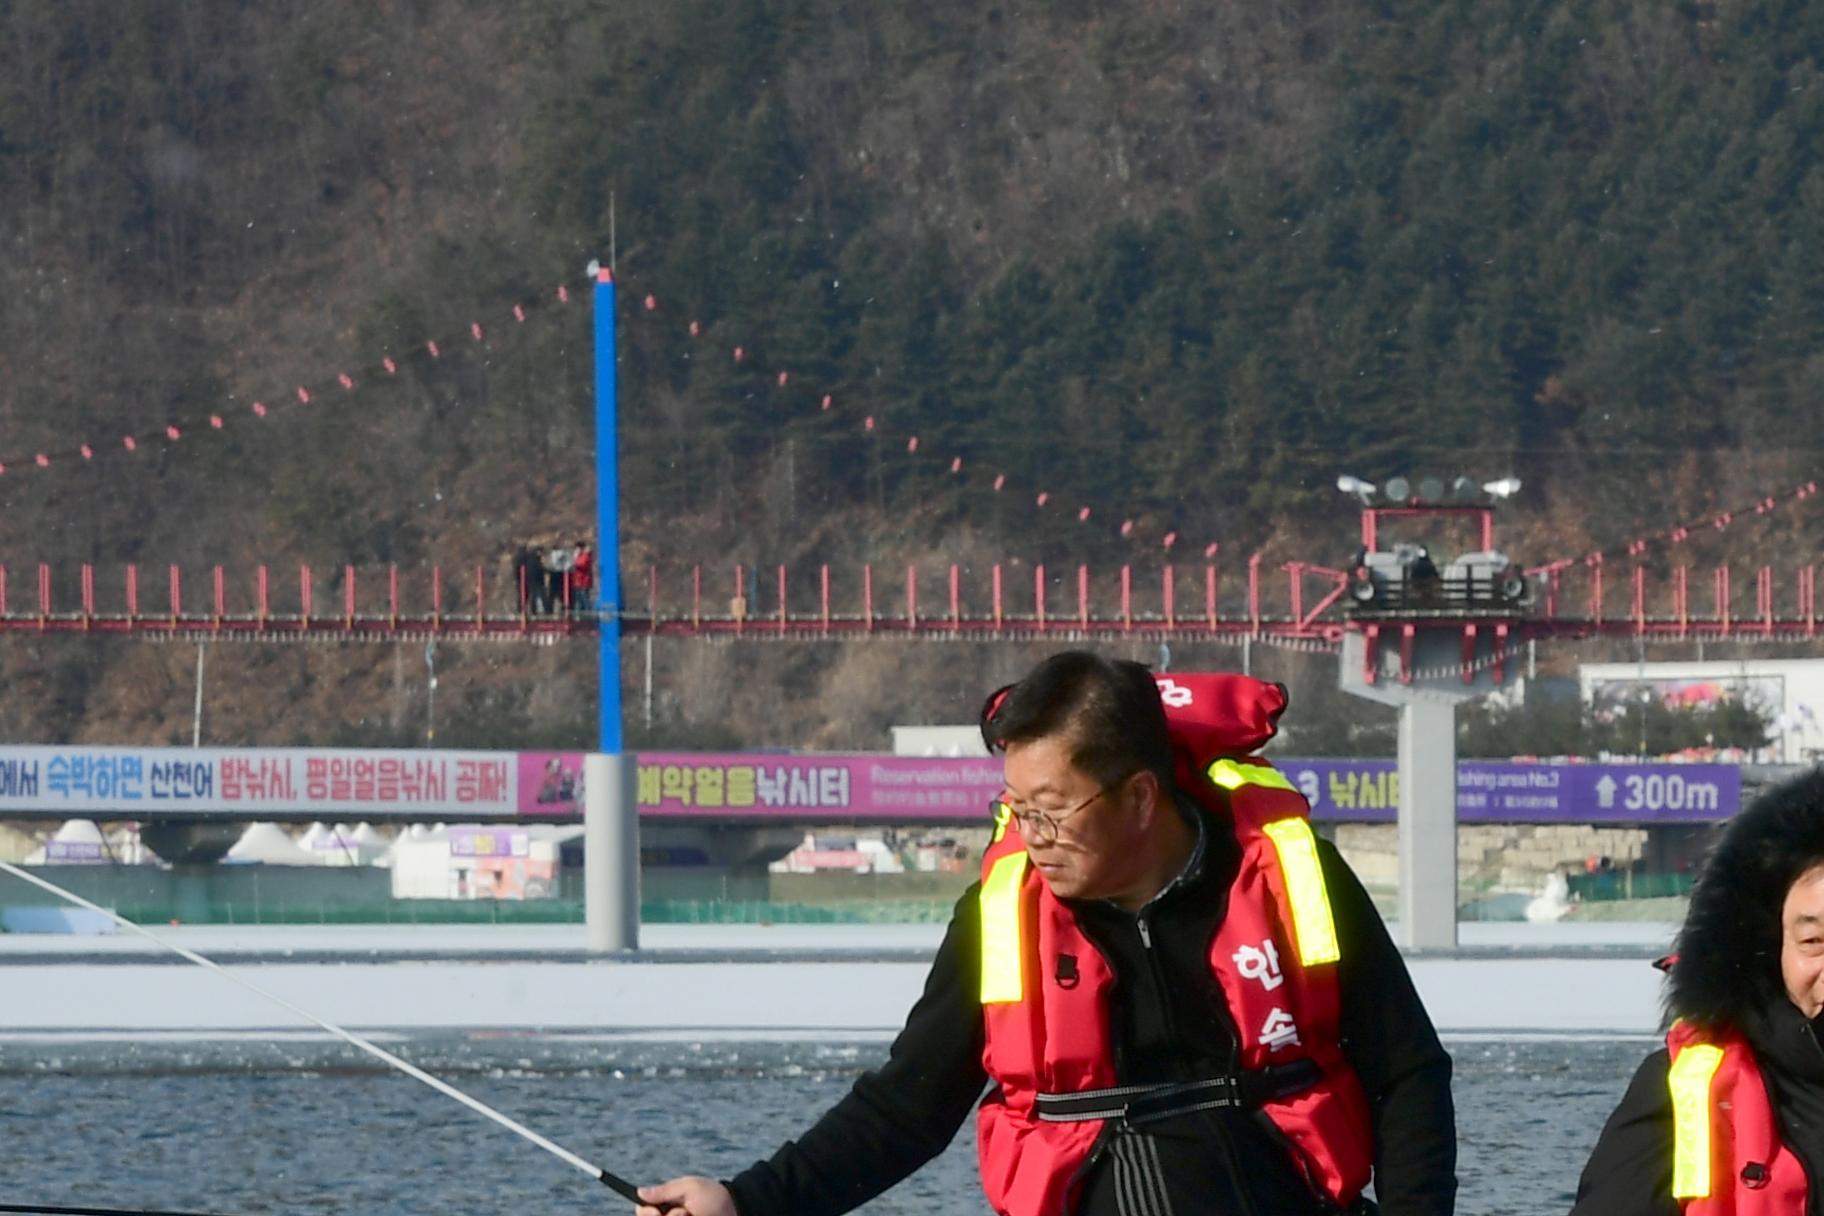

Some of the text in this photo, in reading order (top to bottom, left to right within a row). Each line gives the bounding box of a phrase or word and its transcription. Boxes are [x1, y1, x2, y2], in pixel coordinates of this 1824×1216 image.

[47, 755, 142, 799] 숙박하면
[152, 760, 213, 798] 산천어
[961, 765, 1004, 783] fishin
[1624, 774, 1718, 809] 300m
